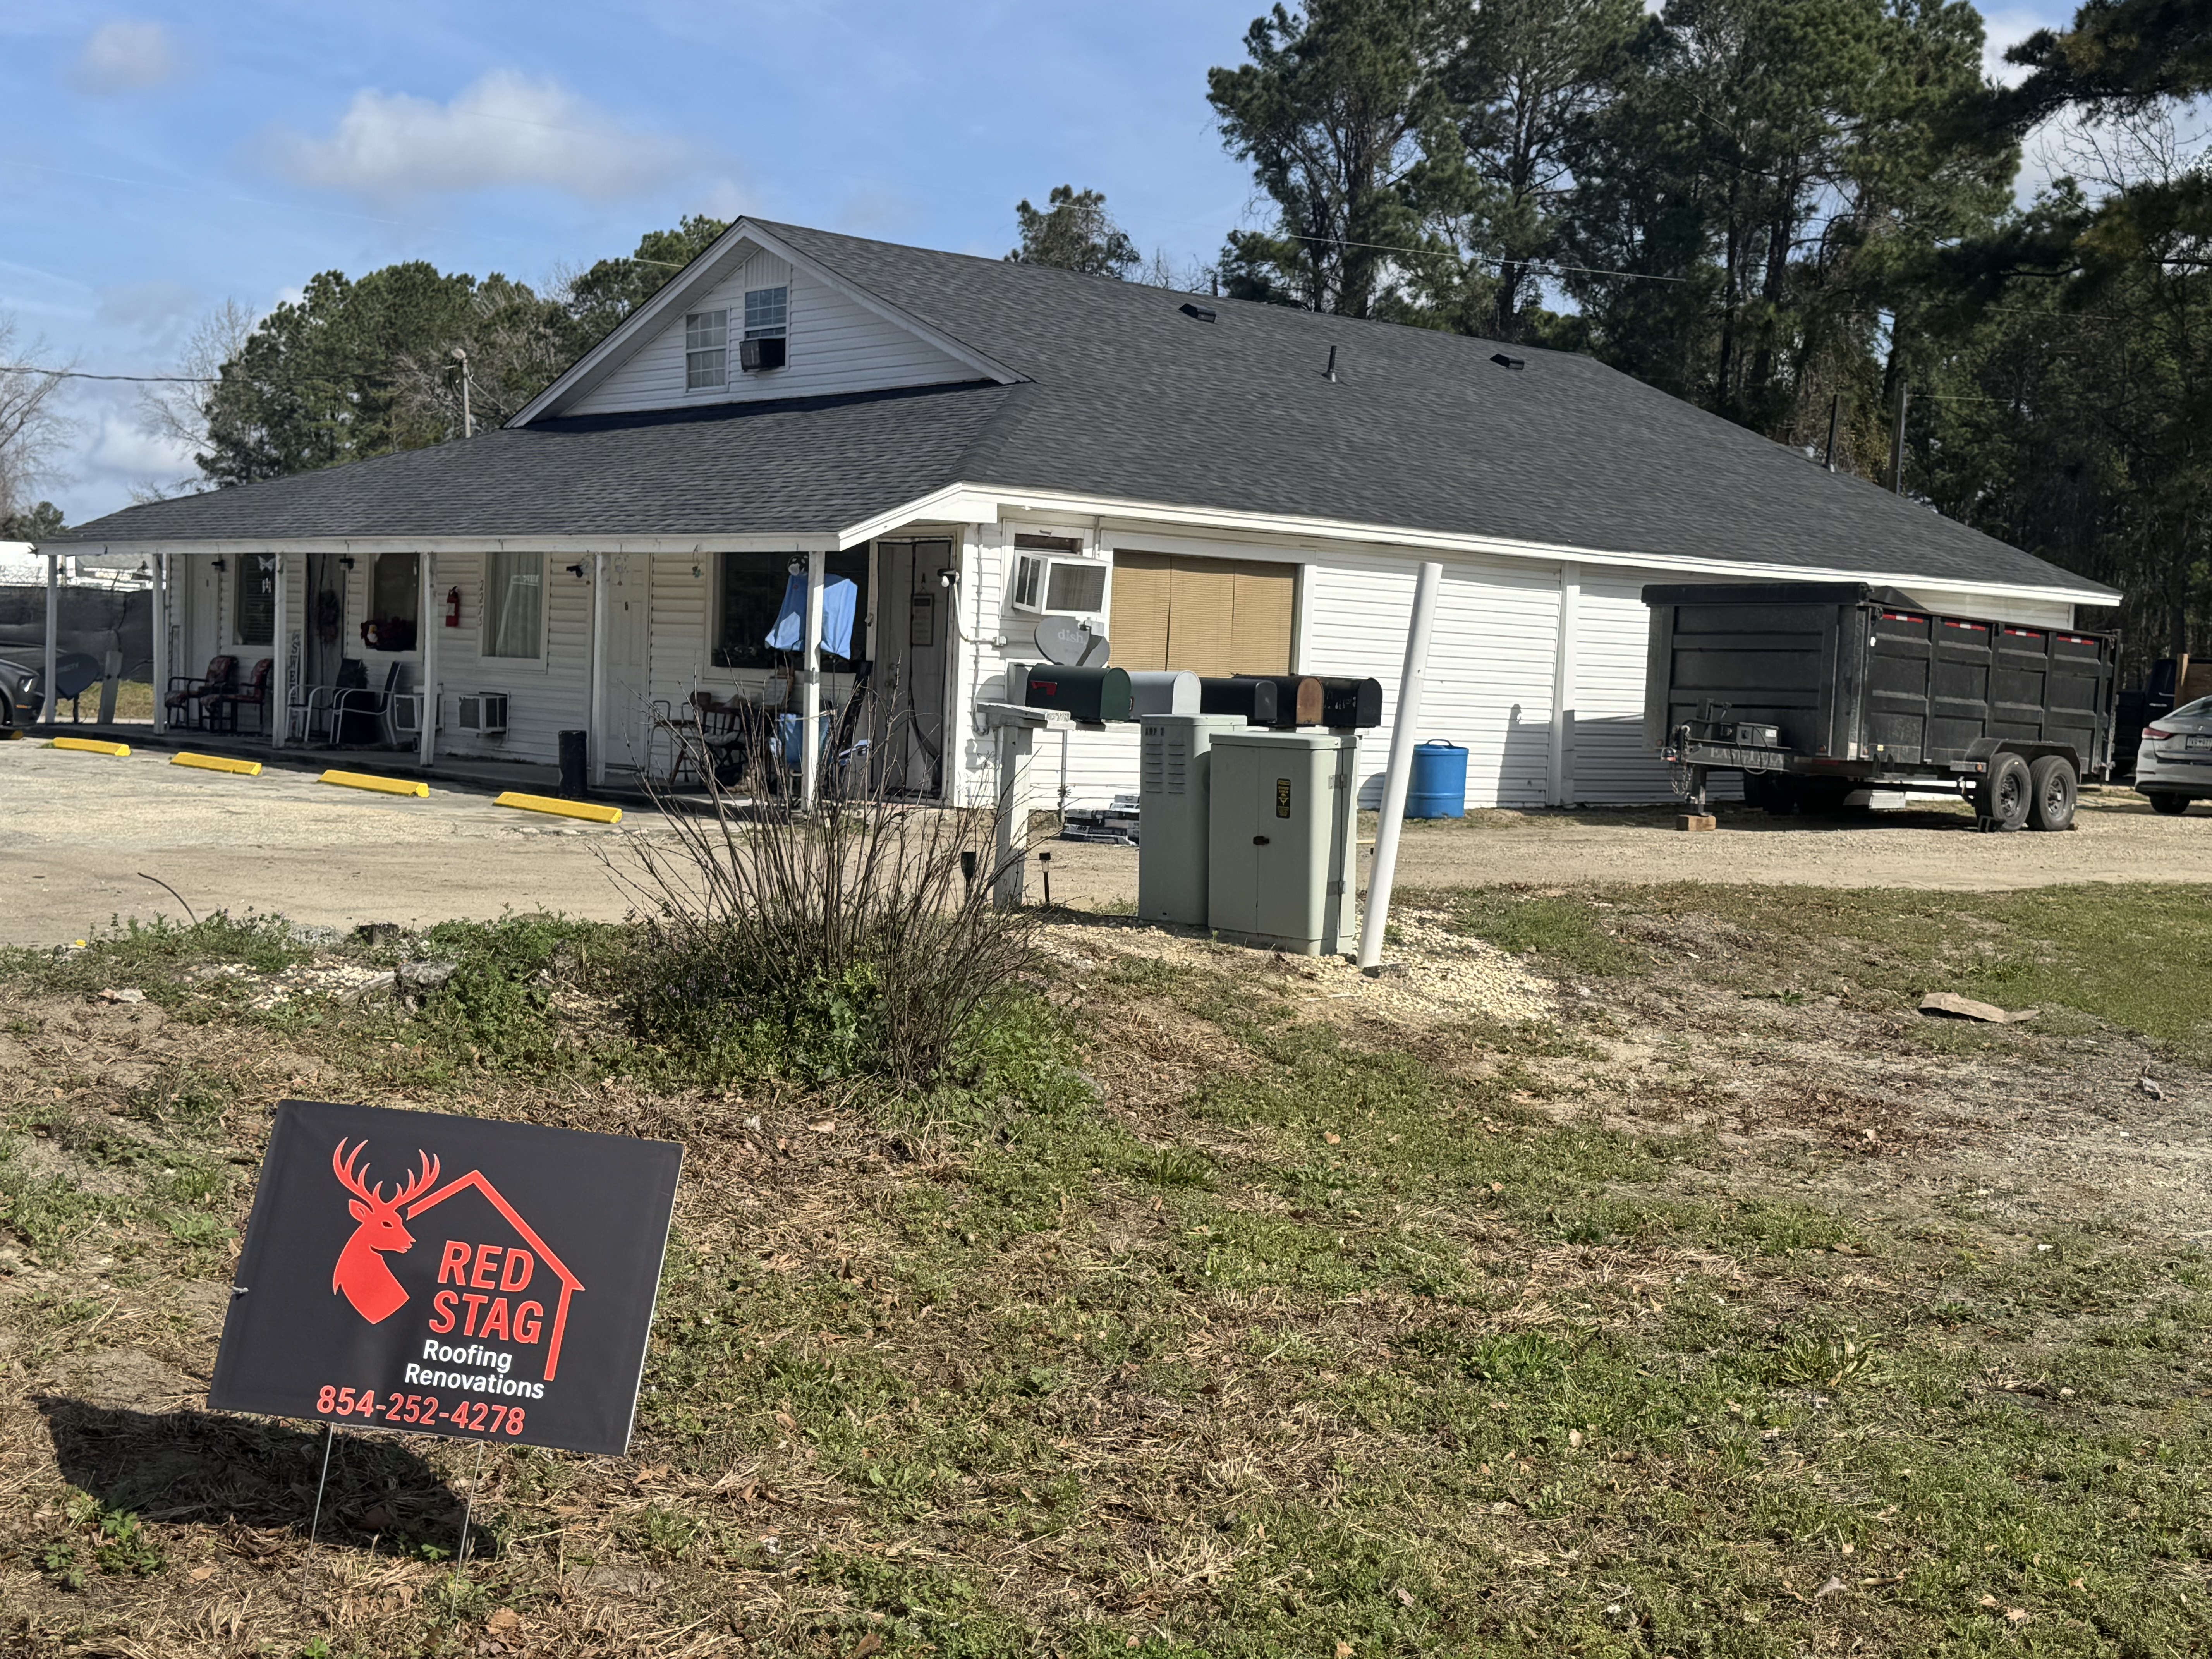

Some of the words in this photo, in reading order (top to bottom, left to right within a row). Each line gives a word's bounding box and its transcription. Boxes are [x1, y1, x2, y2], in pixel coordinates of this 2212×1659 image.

[1058, 629, 1084, 644] dish
[438, 1240, 534, 1292] RED
[429, 1290, 544, 1343] STAG
[423, 1339, 512, 1374] Roofing
[405, 1363, 544, 1399] Renovations
[317, 1385, 525, 1436] 854-252-4278
